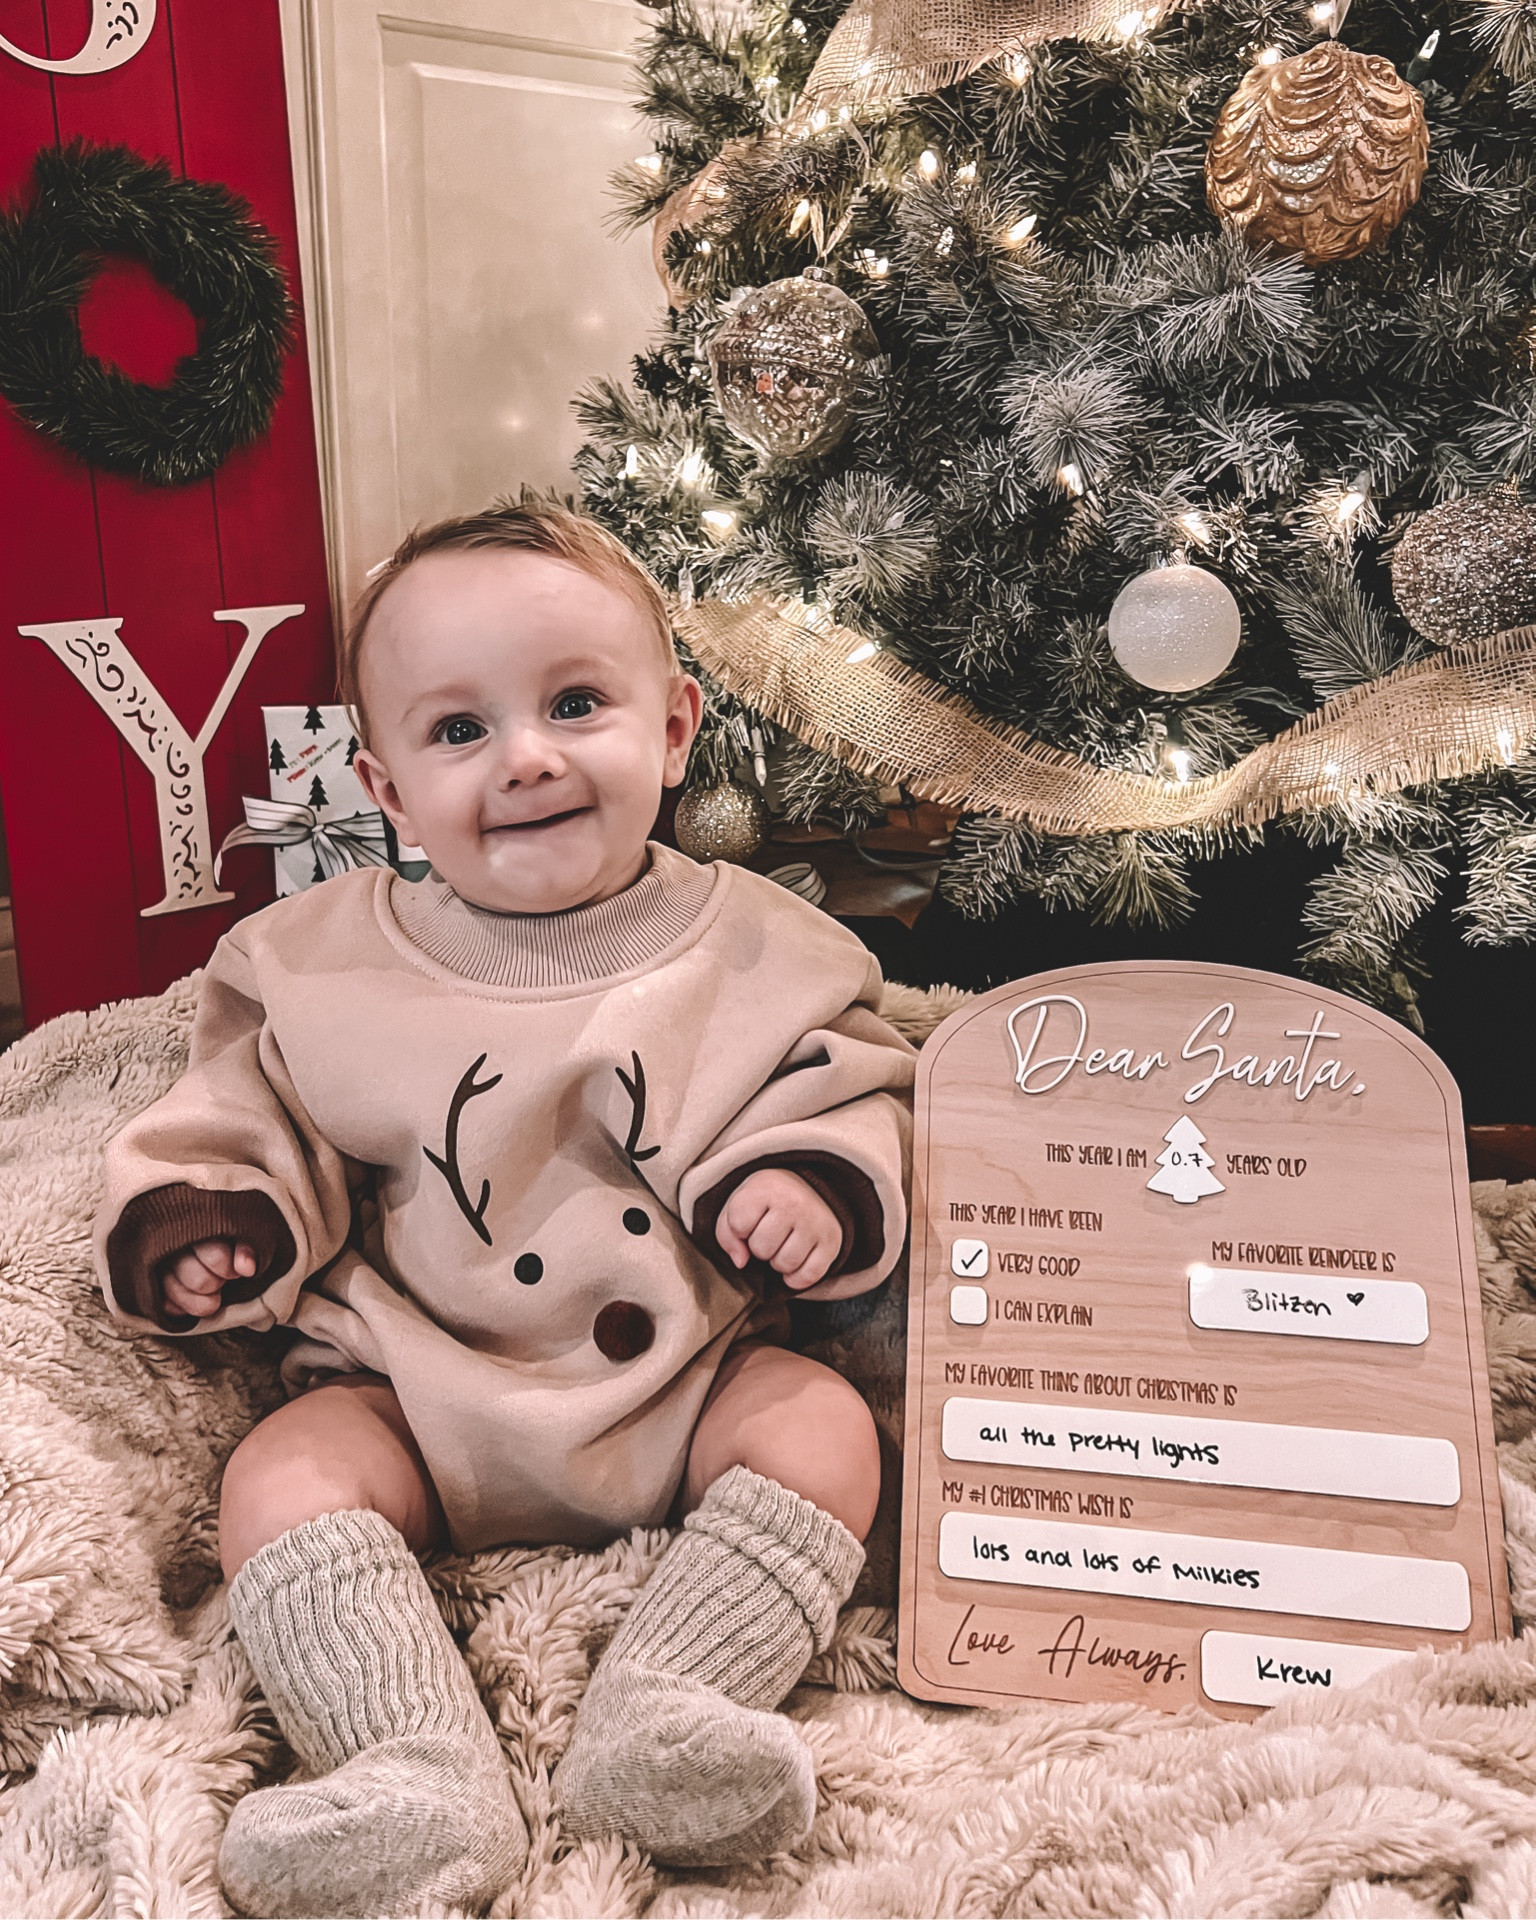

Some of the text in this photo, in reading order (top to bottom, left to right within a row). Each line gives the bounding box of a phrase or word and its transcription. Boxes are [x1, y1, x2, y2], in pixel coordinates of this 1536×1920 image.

[1007, 994, 1366, 1103] Dear Santa,
[1045, 1143, 1147, 1168] THIS YEAR I AM
[1170, 1151, 1204, 1168] 0.7
[1226, 1154, 1307, 1178] YEARS OLD
[949, 1203, 1103, 1232] THIS YEAR I HAVE BEEN
[997, 1252, 1081, 1277] VERY GOOD
[1212, 1241, 1396, 1273] MY FAVORITE REINDEER IS
[995, 1300, 1093, 1327] I CAN EXPLAIN
[1242, 1288, 1332, 1317] Blitzen
[944, 1362, 1238, 1406] MY FAVORITE THING ABOUT CHRISTMAS IS
[979, 1426, 1008, 1443] all
[1020, 1427, 1056, 1446] the
[1068, 1432, 1140, 1460] pretty
[942, 1480, 1134, 1519] MY #1 CHRISTMAS WISH IS
[972, 1535, 1010, 1562] lots
[1024, 1547, 1073, 1568] and
[1082, 1548, 1119, 1572] lots
[1132, 1556, 1161, 1574] of
[947, 1604, 1015, 1666] Love
